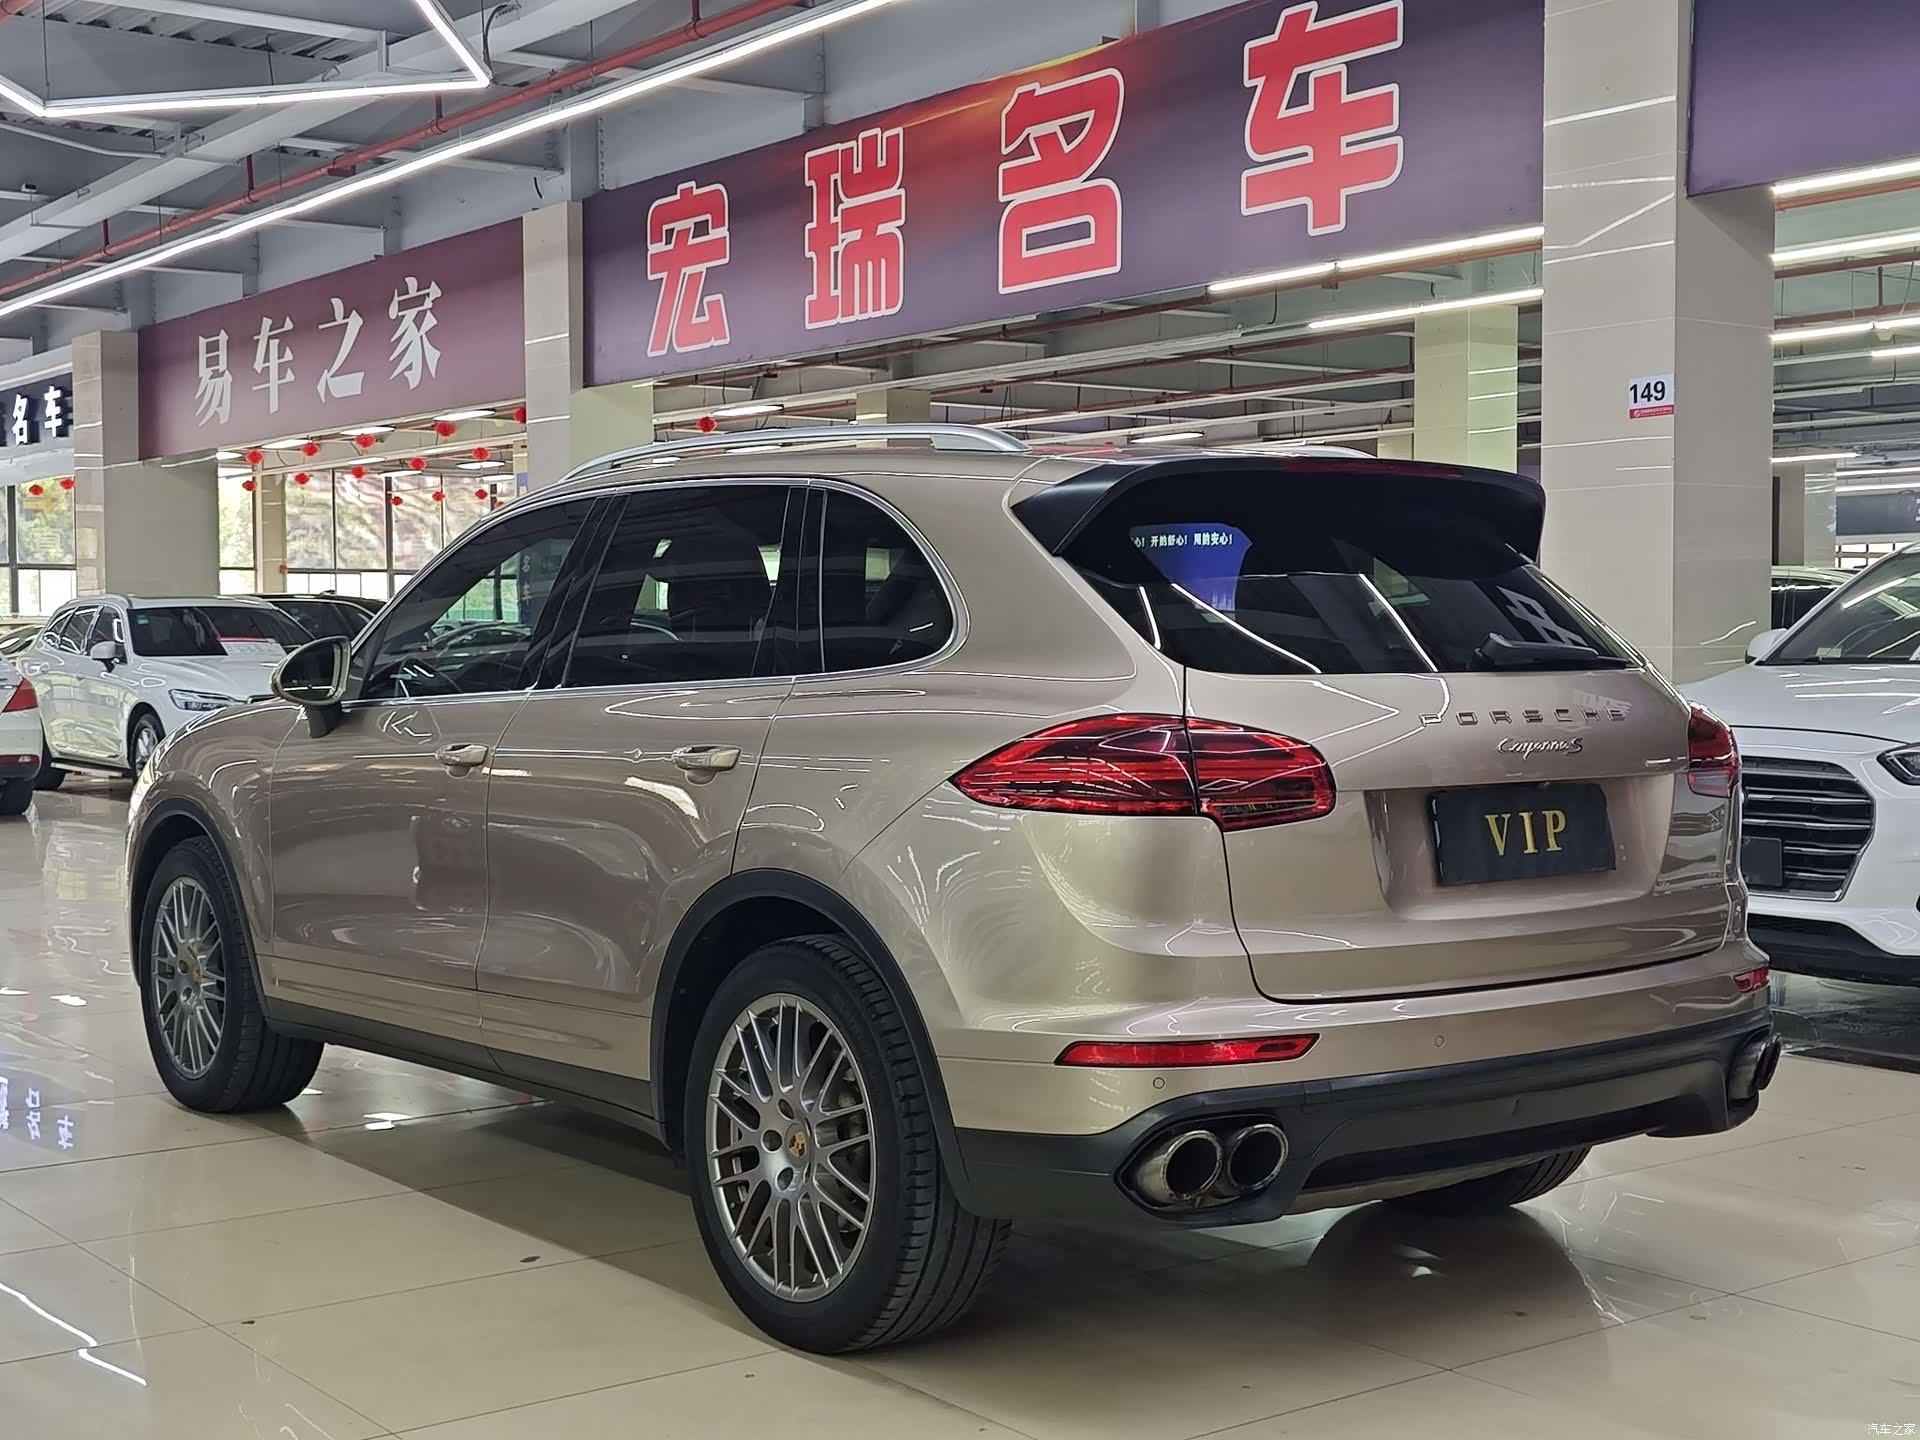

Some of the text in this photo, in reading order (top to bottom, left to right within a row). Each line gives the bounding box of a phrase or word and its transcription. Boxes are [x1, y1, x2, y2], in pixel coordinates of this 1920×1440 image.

[646, 1, 1404, 358] 宏瑞名车
[195, 276, 442, 427] 易车之家
[1630, 381, 1666, 404] 149
[1419, 708, 1626, 726] PORSCHE
[1497, 737, 1584, 760] Cayenne S
[1485, 810, 1567, 856] VIP
